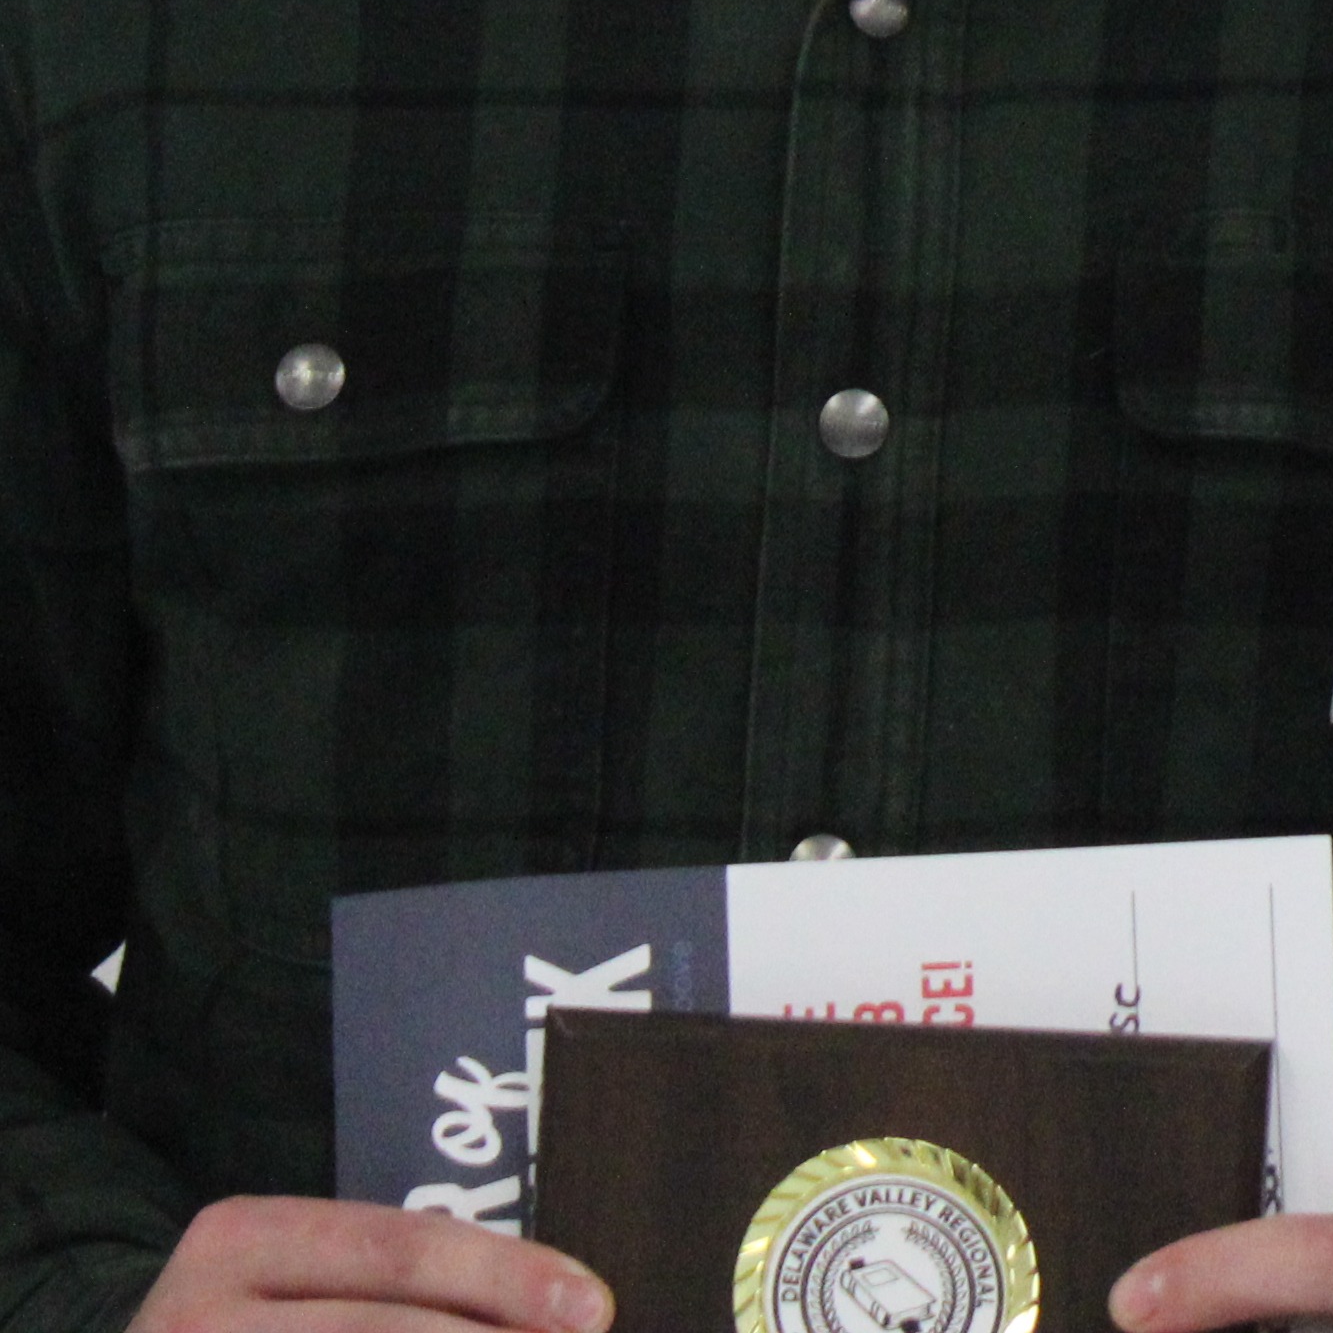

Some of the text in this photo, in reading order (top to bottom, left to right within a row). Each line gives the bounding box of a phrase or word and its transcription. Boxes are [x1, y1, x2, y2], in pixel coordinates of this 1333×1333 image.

[782, 1187, 996, 1307] DELAWARE VALLEY REGIONAL
